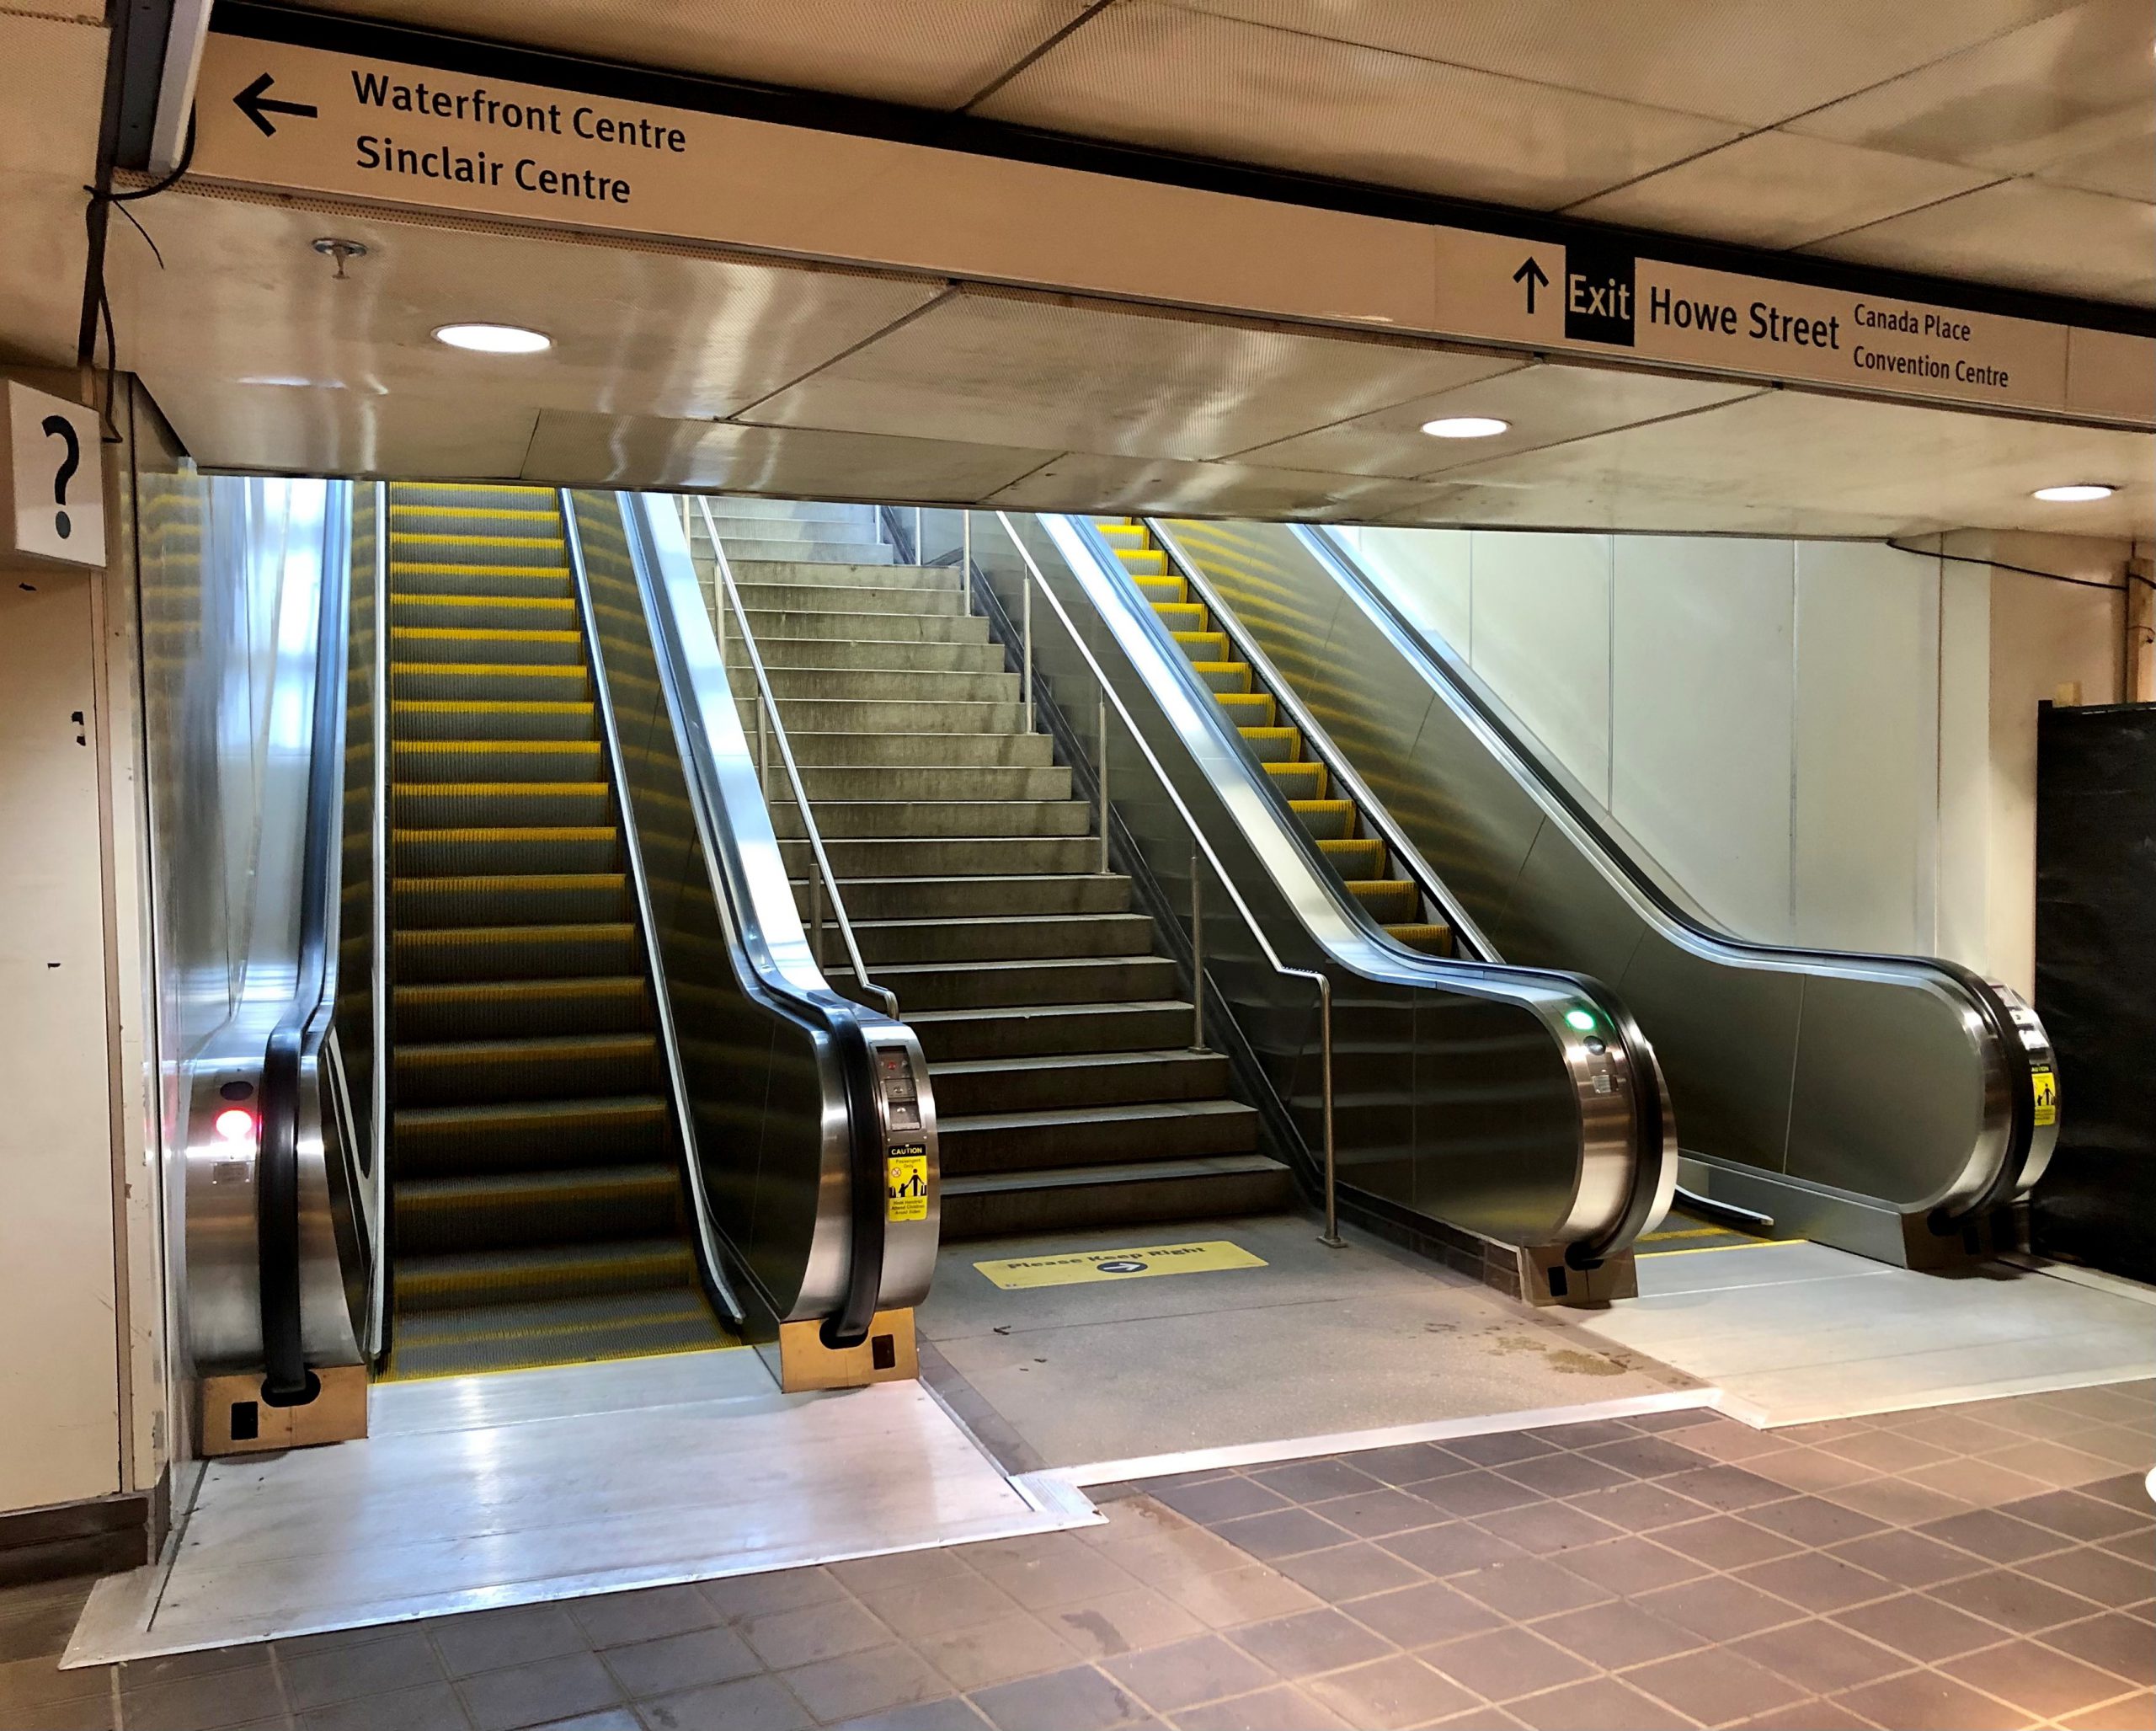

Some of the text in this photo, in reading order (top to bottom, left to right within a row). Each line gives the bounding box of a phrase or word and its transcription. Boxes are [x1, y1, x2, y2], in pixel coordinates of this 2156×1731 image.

[350, 70, 686, 152] Waterfront Centre
[356, 135, 630, 204] Sinclair Centre
[1569, 273, 1631, 320] Exit
[1651, 286, 1840, 350] Howe Street
[1854, 303, 1971, 342] Canada Place
[1853, 345, 2009, 388] Convention Centre
[1007, 1246, 1206, 1269] Please Keep Right
